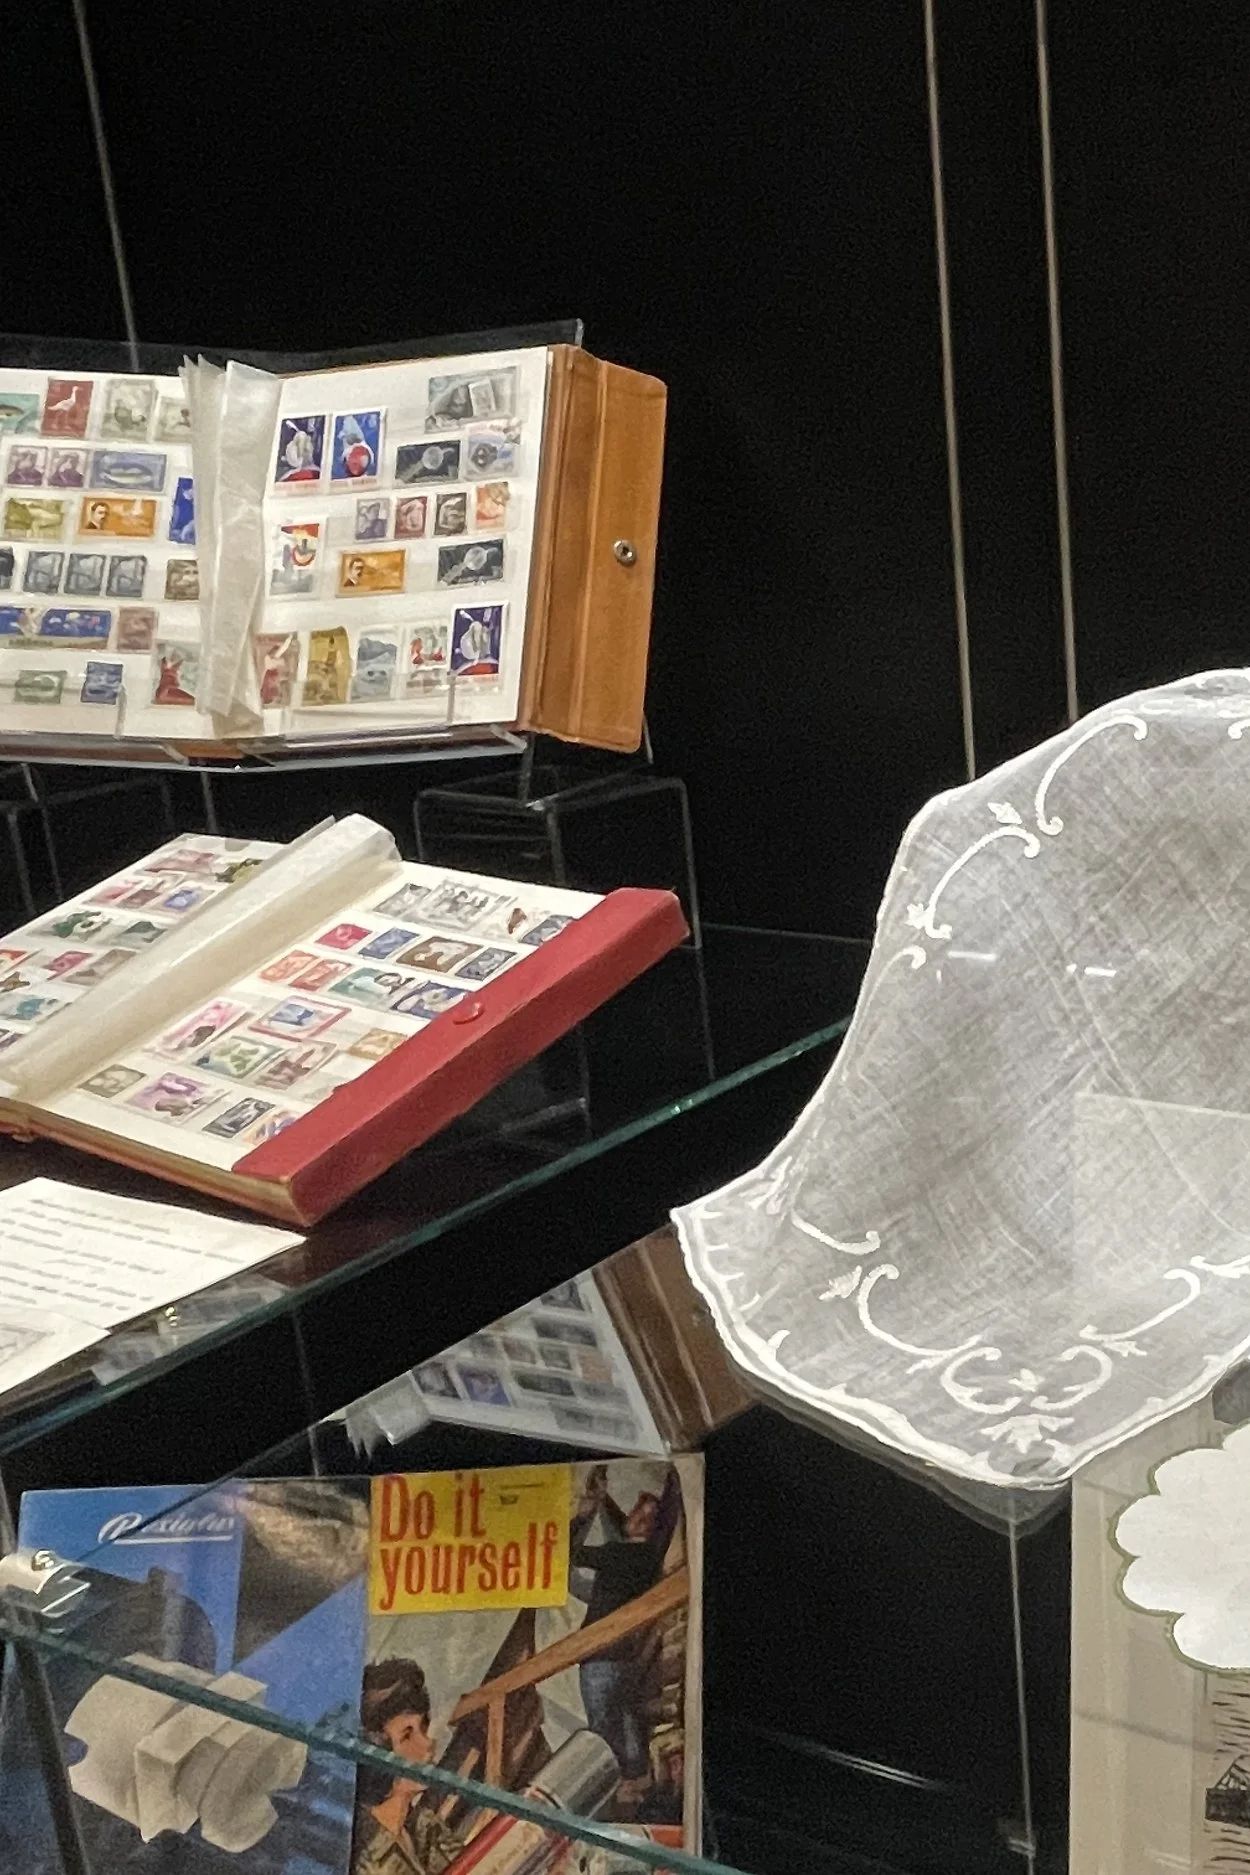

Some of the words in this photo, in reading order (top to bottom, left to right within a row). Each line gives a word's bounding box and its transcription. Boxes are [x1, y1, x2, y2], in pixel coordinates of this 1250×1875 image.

[380, 1475, 436, 1542] Do
[454, 1472, 487, 1539] it
[379, 1521, 558, 1611] yourself
